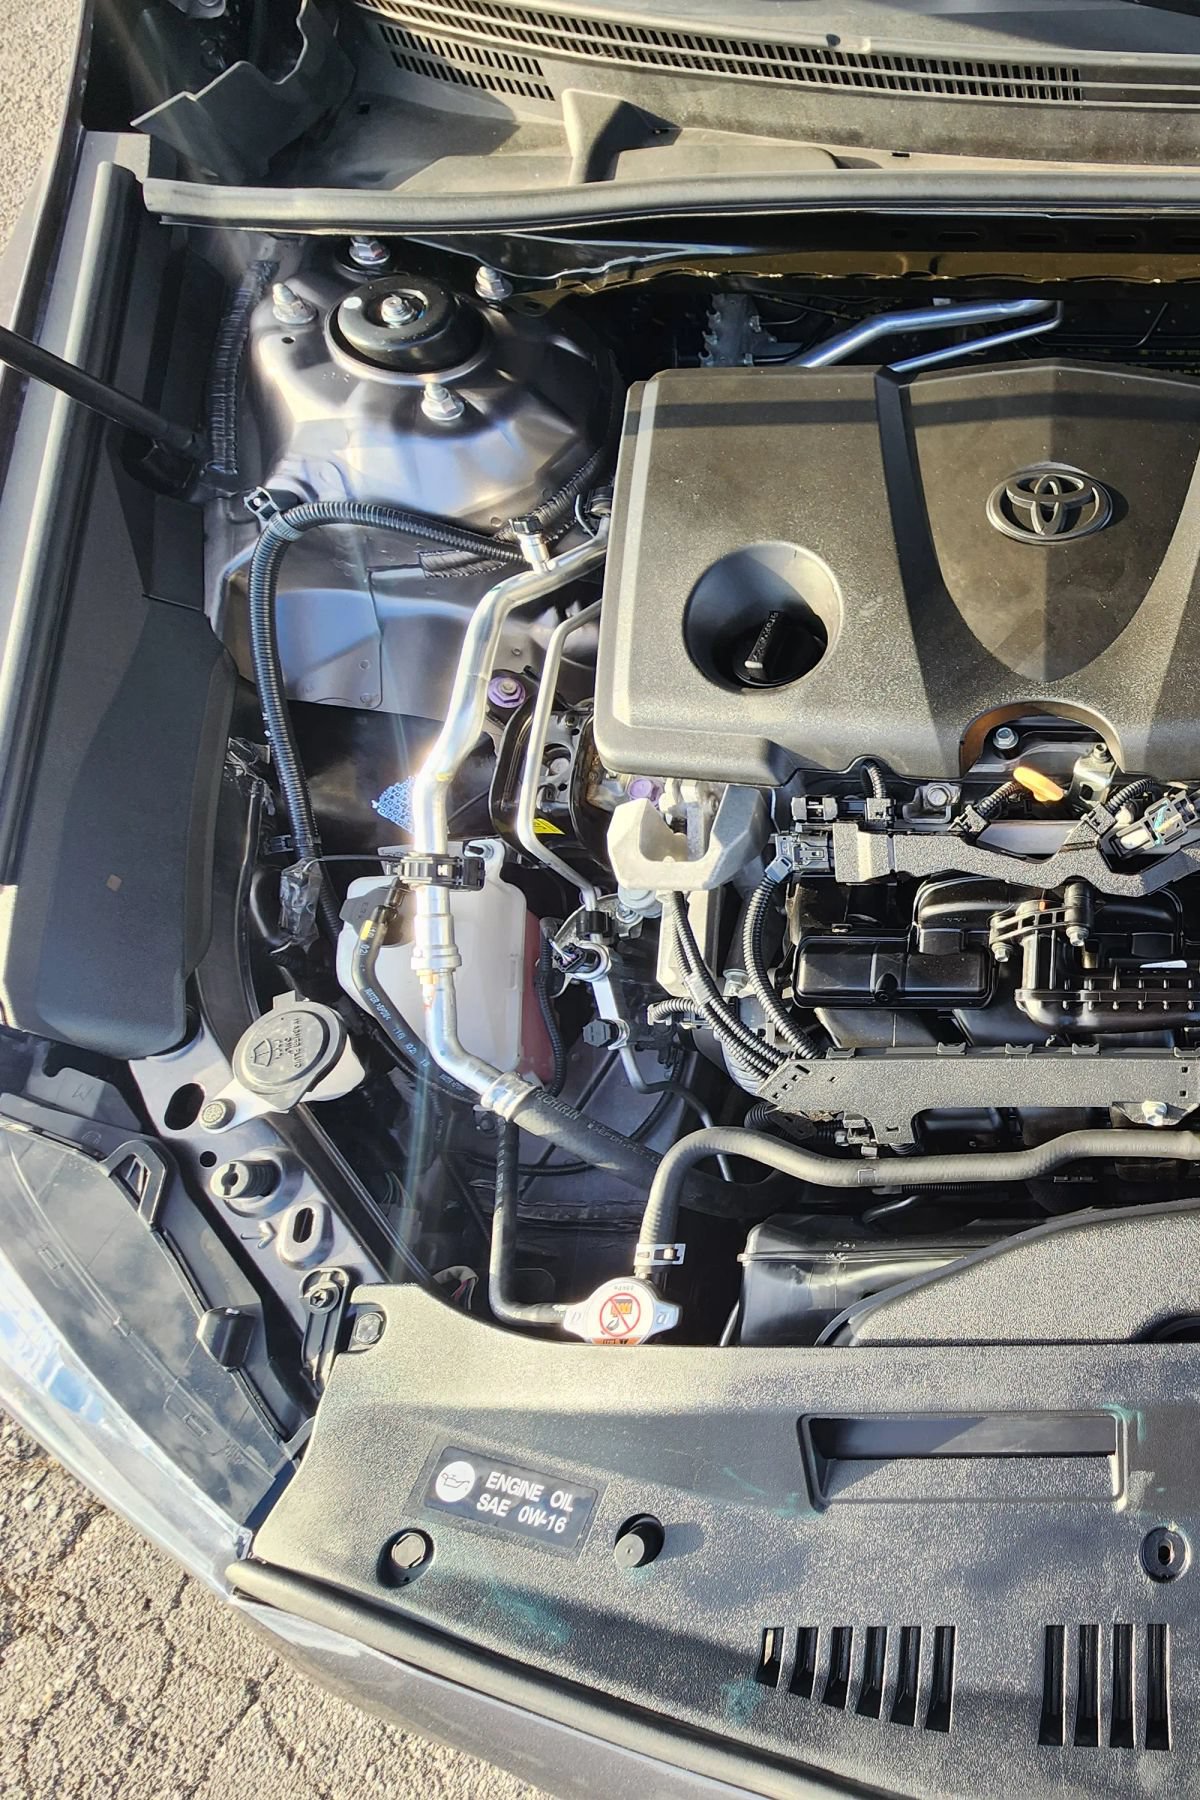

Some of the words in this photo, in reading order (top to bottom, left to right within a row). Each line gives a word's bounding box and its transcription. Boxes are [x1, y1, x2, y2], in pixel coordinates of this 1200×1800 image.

[532, 1089, 582, 1120] NICHIRIN
[485, 1471, 545, 1502] ENGINE
[550, 1490, 574, 1512] OIL
[476, 1493, 512, 1518] SAE
[517, 1504, 568, 1534] 0W-16
